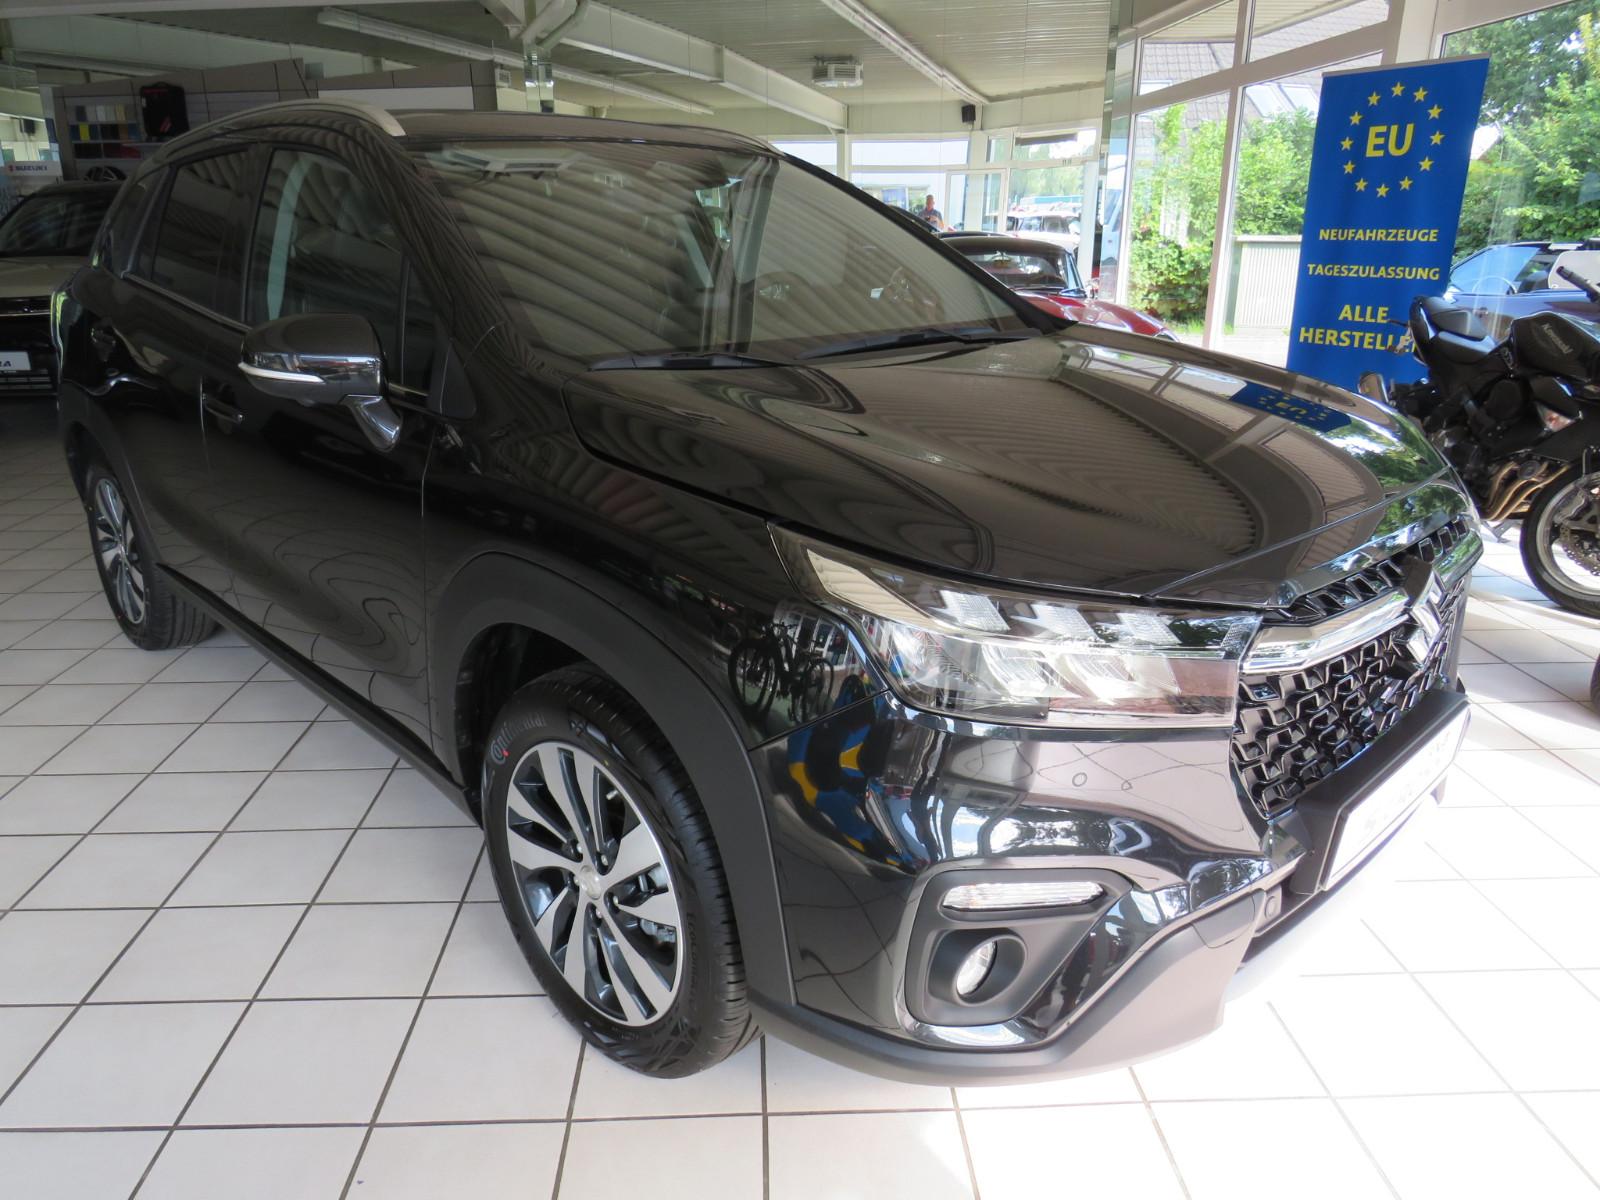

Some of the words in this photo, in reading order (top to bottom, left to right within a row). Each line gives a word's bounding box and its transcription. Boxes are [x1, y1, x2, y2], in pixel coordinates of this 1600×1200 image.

[1365, 123, 1415, 158] EU
[1319, 228, 1438, 242] NEUFAHRZEUGE
[1307, 263, 1440, 280] TAGESZULASSUNG
[1338, 304, 1389, 324] ALLE
